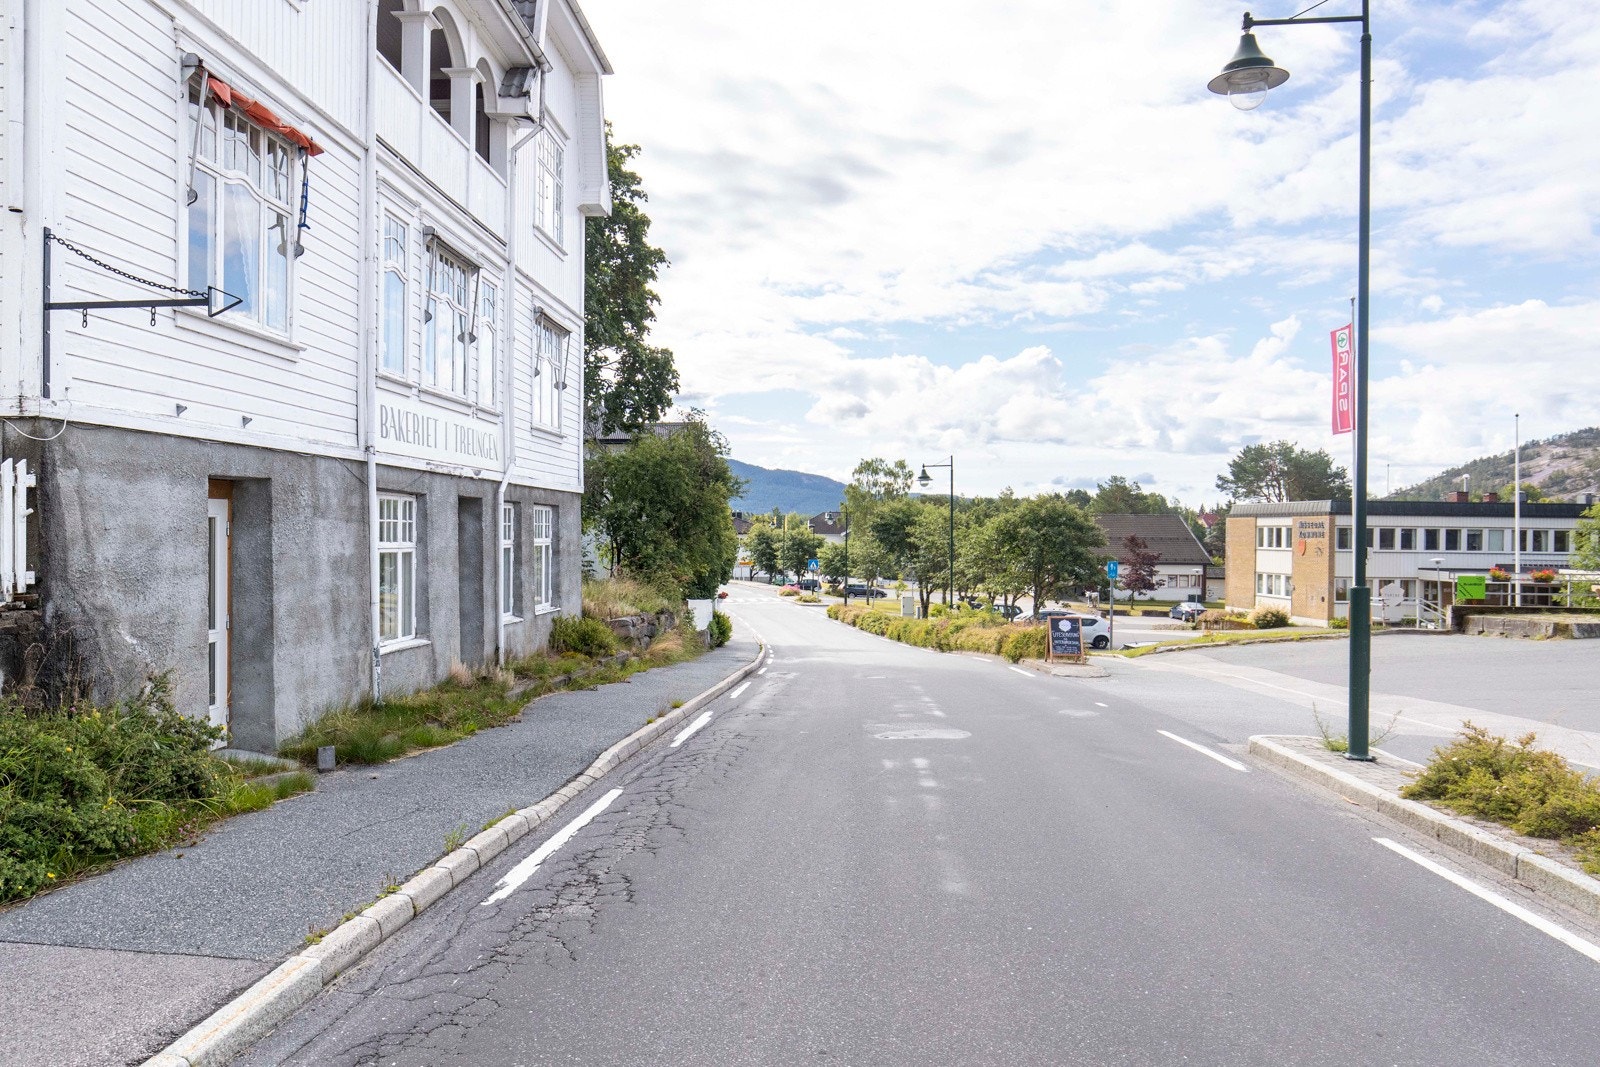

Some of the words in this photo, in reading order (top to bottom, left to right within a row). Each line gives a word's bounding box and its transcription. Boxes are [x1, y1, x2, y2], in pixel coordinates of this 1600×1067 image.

[380, 404, 439, 449] BAKERIET
[445, 422, 448, 451] I
[454, 423, 498, 461] TREUNGEN
